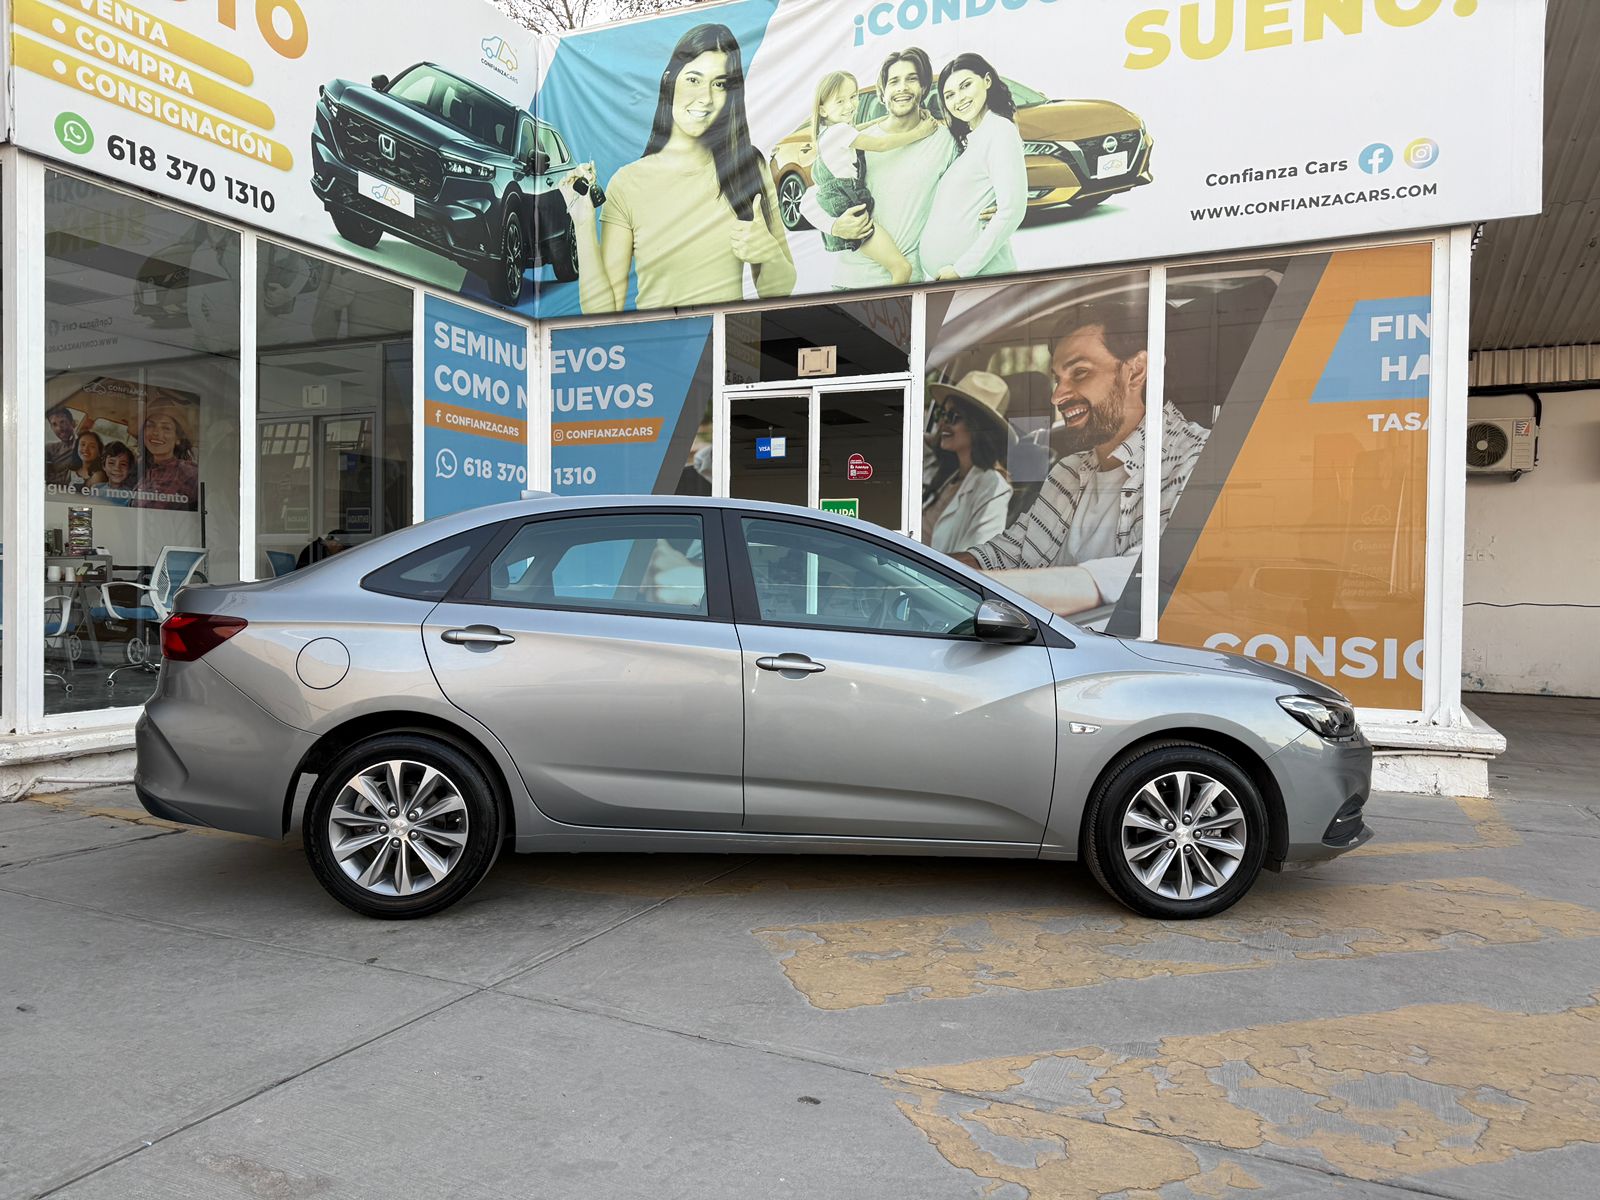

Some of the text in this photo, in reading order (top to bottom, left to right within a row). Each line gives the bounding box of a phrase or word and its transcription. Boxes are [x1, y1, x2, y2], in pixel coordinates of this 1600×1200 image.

[75, 25, 195, 95] COMPRA
[75, 65, 273, 162] CONSIGNACIÓN
[107, 134, 275, 213] 618 370 1310
[1205, 157, 1349, 188] Confianza Cars
[1190, 183, 1438, 222] WWW.CONFIANZACARS.COM
[1370, 313, 1430, 342] FIN
[434, 364, 510, 406] COMO
[551, 382, 655, 413] UEVOS
[445, 412, 520, 437] CONFIANZACARS
[566, 426, 654, 440] CONFIANZACARS
[463, 456, 597, 486] 618 370 1310
[81, 486, 99, 497] en
[106, 487, 190, 503] movimiento
